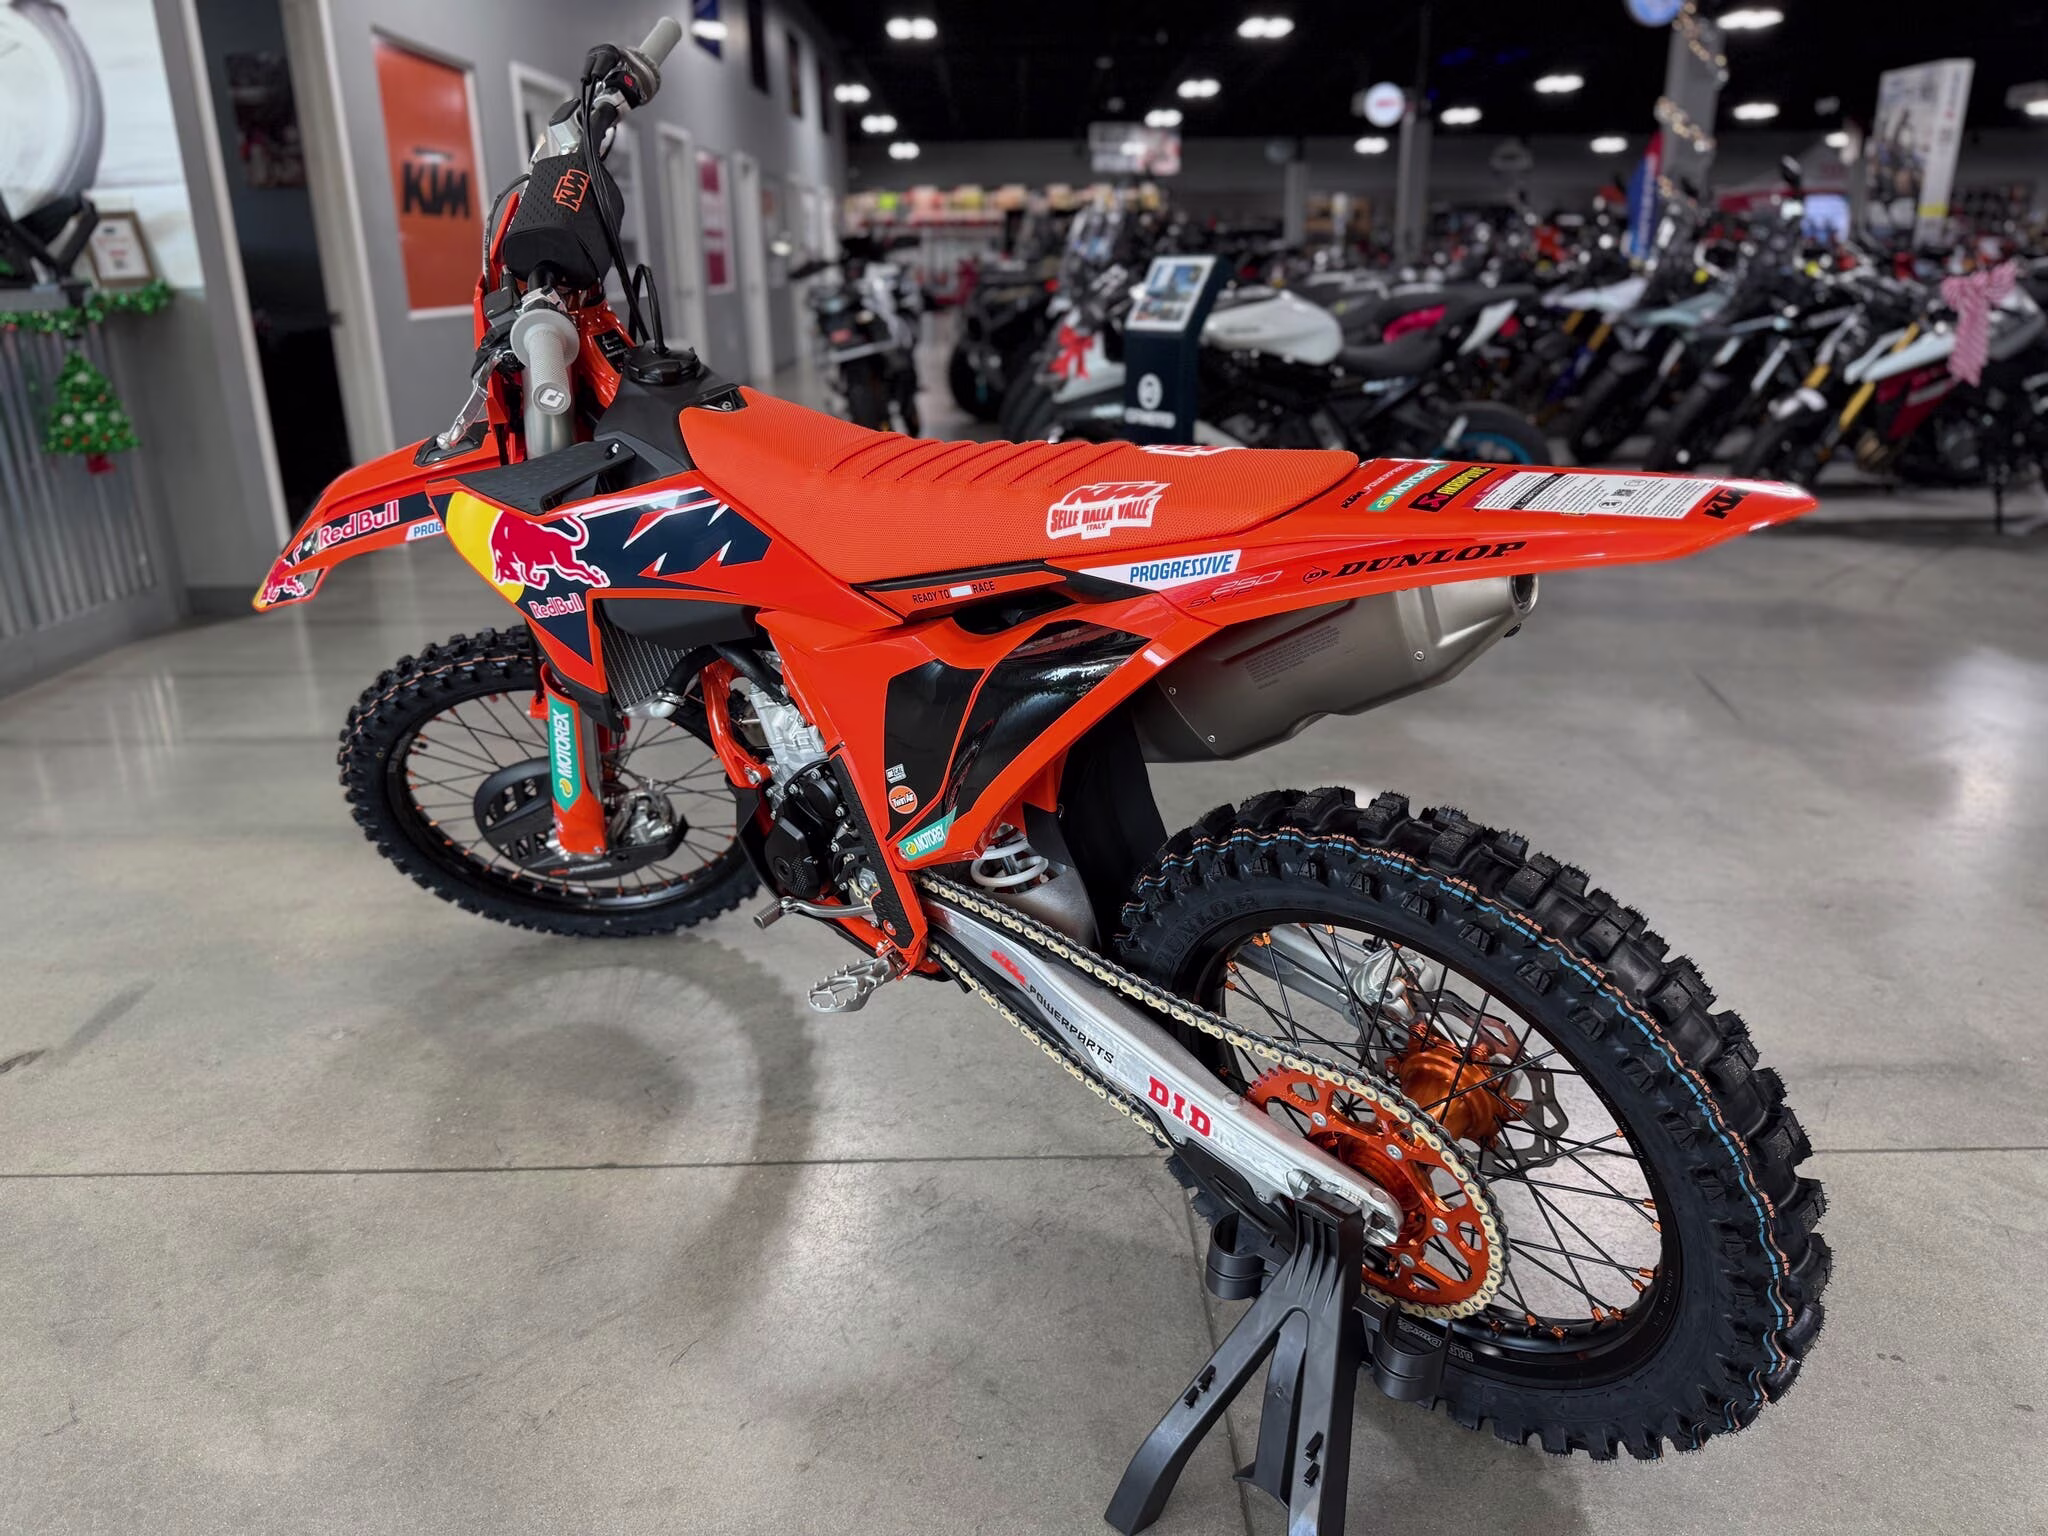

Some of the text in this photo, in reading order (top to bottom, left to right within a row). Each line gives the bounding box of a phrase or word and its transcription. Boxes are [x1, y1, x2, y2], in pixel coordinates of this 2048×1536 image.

[402, 150, 471, 219] KTM
[554, 169, 591, 212] KTM
[1062, 481, 1171, 506] KTM
[319, 499, 400, 550] Red Bull
[1051, 499, 1150, 532] SELLE DALLA VALLE
[1086, 522, 1106, 531] ITALY
[1130, 553, 1234, 583] PROGRESSIVE
[1332, 541, 1528, 578] DUNLOP
[528, 592, 585, 619] Red Bull
[912, 580, 996, 605] READY TO RACE
[552, 708, 573, 778] MOTOREX
[913, 823, 946, 852] MOTOREX
[1029, 984, 1116, 1064] POWERPARTS
